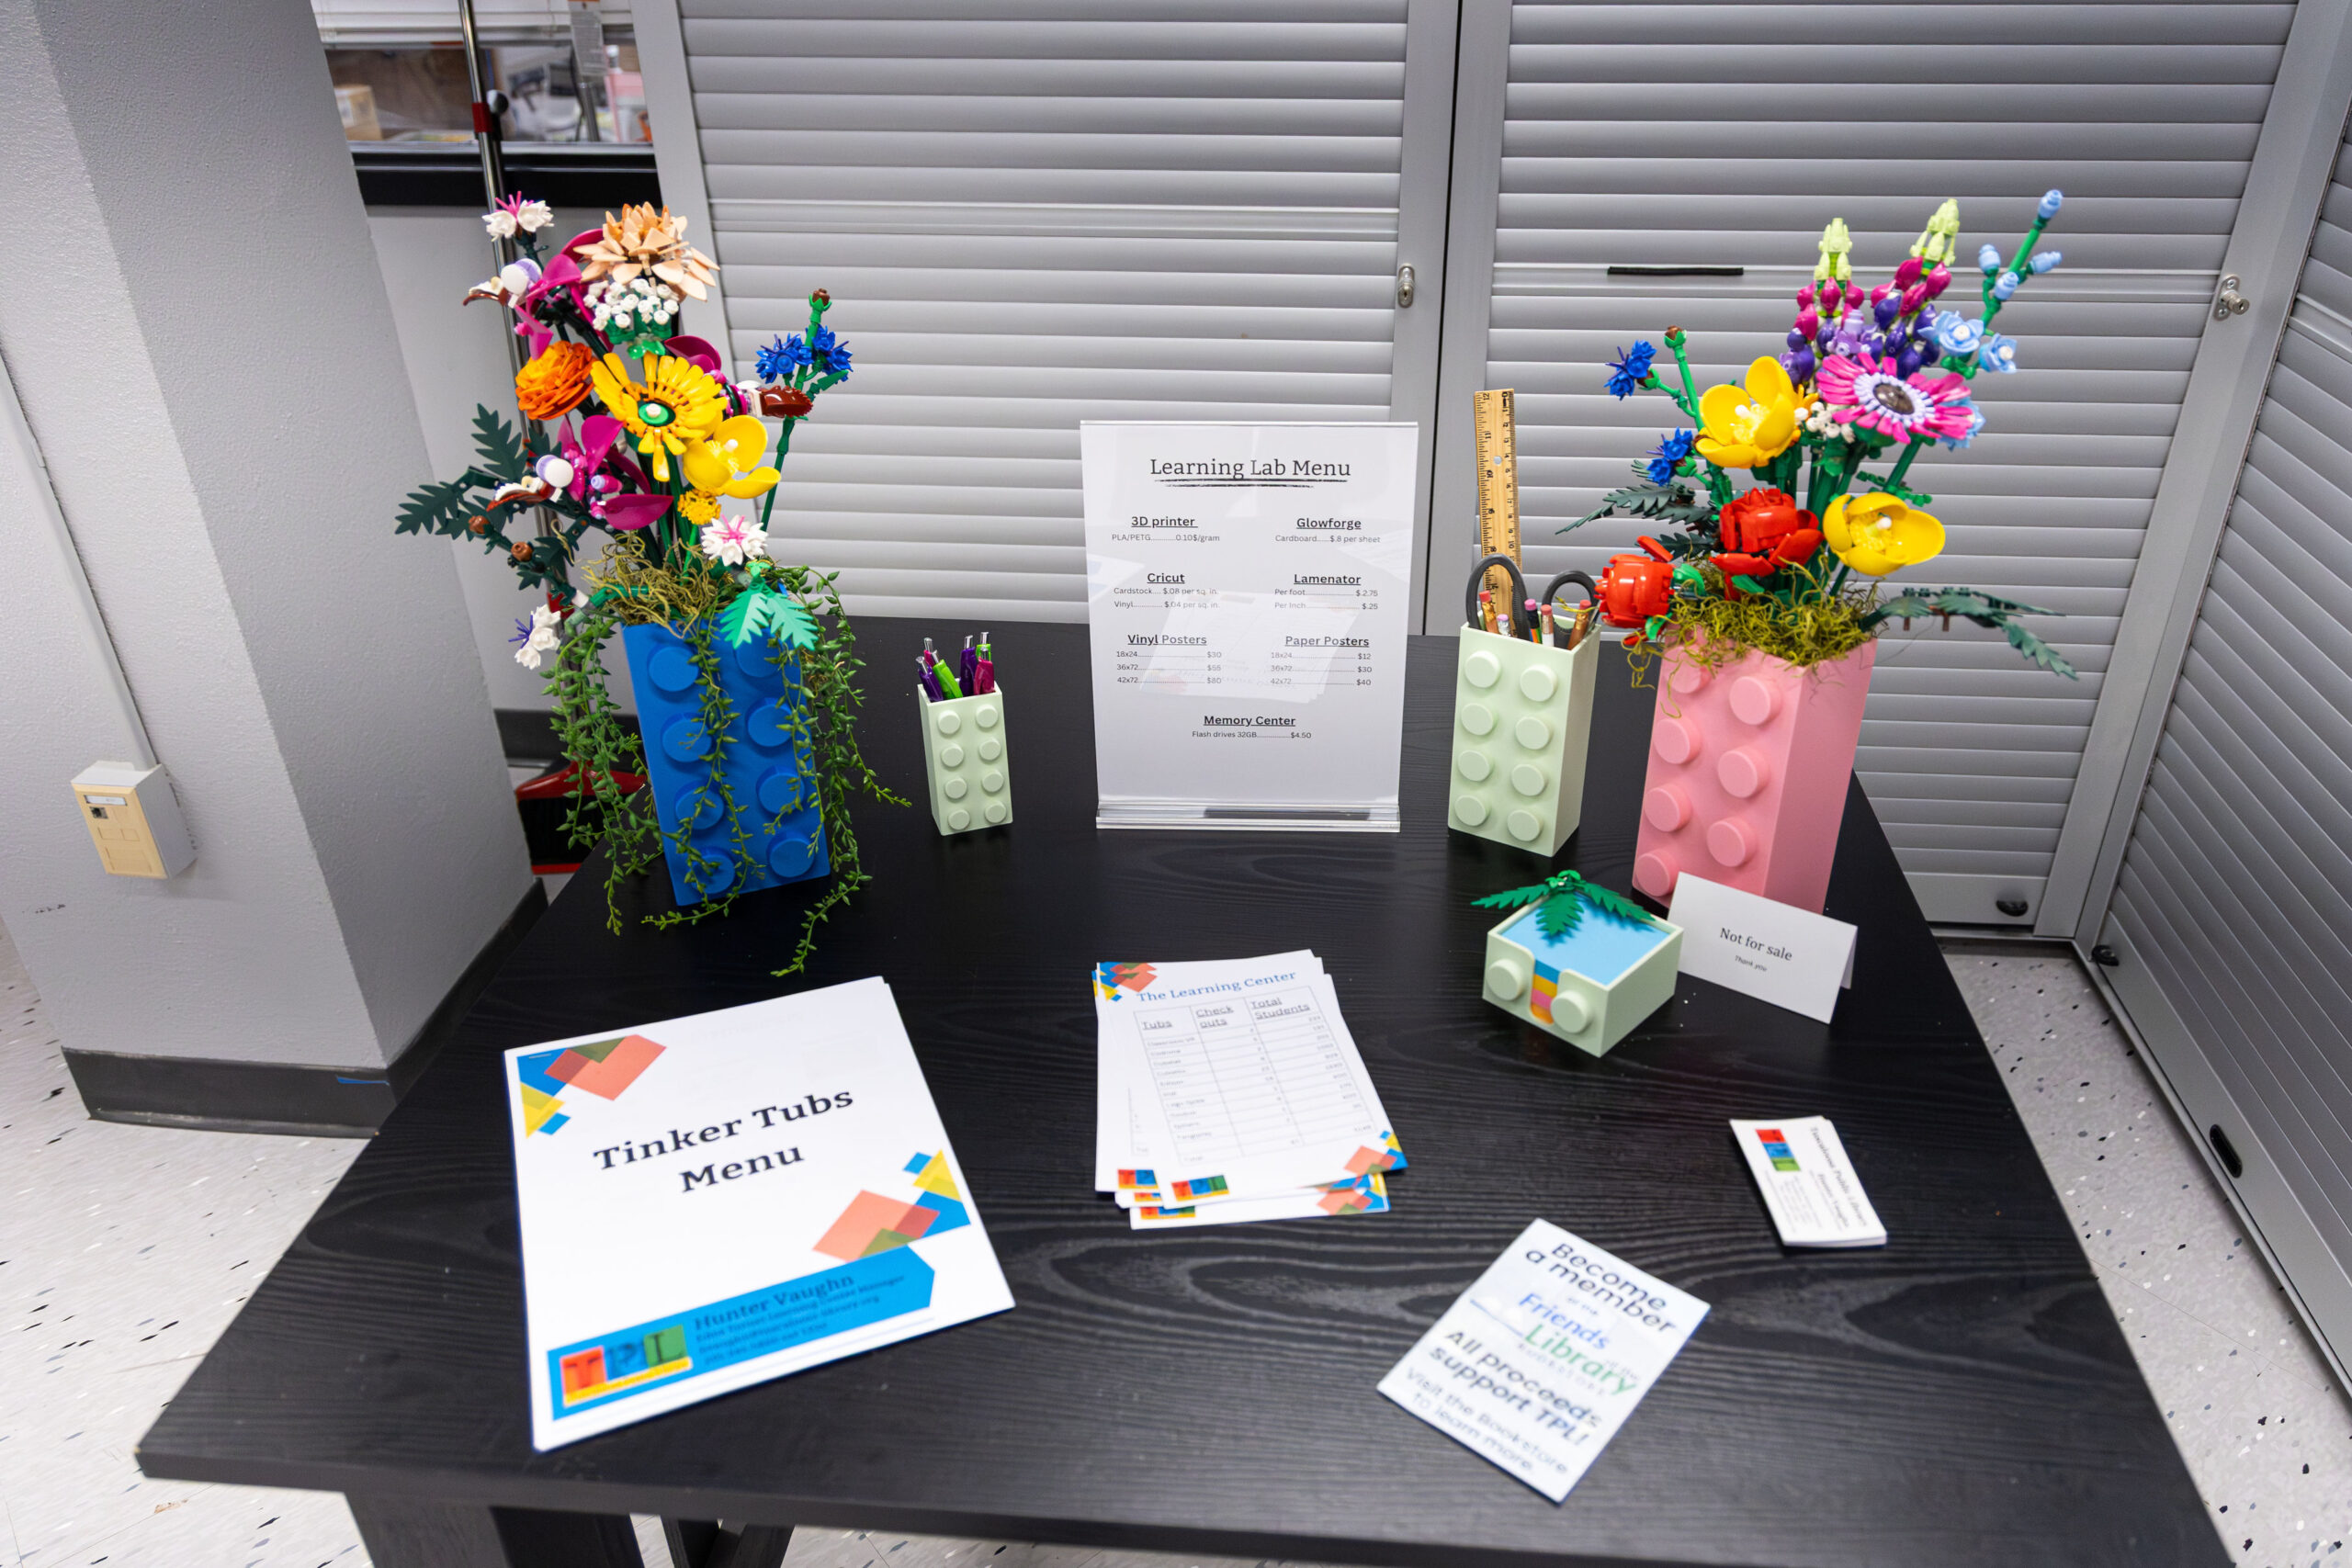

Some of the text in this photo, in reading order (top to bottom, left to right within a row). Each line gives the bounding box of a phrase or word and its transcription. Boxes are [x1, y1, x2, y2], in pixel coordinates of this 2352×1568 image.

[1150, 458, 1351, 480] Learning Lab Menu
[1131, 516, 1195, 528] 3D printer
[1296, 518, 1362, 530] Glowforge
[1147, 573, 1185, 583] Cricut
[1294, 574, 1362, 584] Lamenator
[1127, 635, 1207, 646] Vinyl Posters
[1285, 637, 1370, 647] Paper Posters
[1204, 716, 1296, 727] Memory Center
[1720, 927, 1793, 962] Not for sale
[1735, 954, 1754, 968] Thank
[1136, 971, 1297, 1003] The Learning Center
[1195, 1005, 1234, 1020] Check
[1250, 998, 1283, 1010] Total
[1254, 1002, 1311, 1021] Students
[1141, 1018, 1173, 1031] Tubs
[1199, 1017, 1227, 1029] outs
[593, 1089, 855, 1170] Tinker Tubs
[678, 1145, 805, 1194] Menu
[1552, 1243, 1668, 1311] Become
[1525, 1249, 1677, 1331] a member
[695, 1297, 770, 1331] Hunter
[773, 1275, 855, 1307] Vaughn
[1519, 1292, 1610, 1349] Friends
[1525, 1324, 1637, 1395] Library
[1445, 1331, 1602, 1428] All proceeds
[1430, 1347, 1590, 1447] support TPL!
[1406, 1367, 1568, 1472] Visit the Bookstore
[1435, 1405, 1481, 1439] learn
